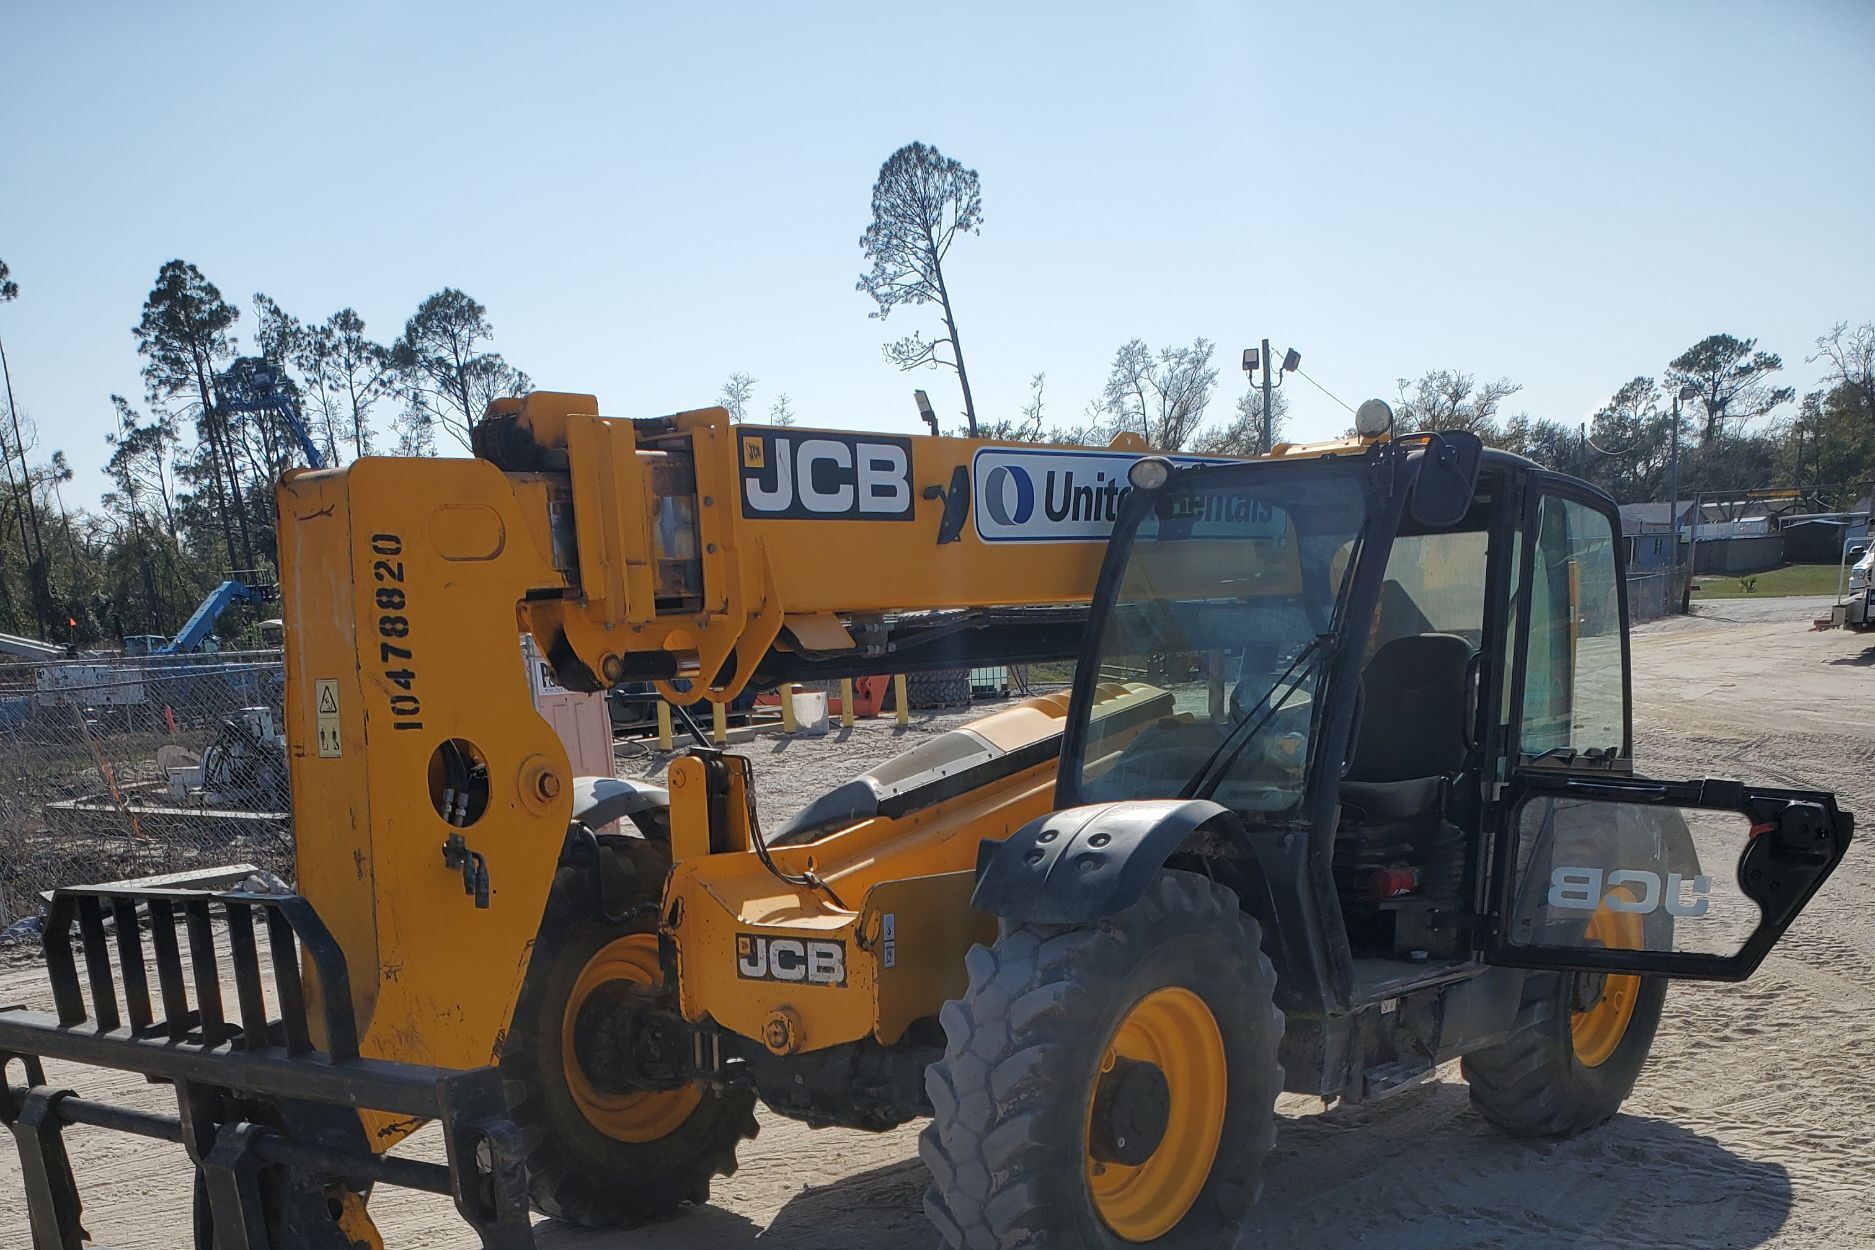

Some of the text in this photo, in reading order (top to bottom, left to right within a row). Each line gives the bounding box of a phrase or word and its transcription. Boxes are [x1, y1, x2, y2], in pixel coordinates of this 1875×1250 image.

[746, 438, 910, 513] JCB
[1044, 471, 1135, 522] Unit
[371, 533, 423, 730] 10478820
[739, 938, 845, 982] JCB
